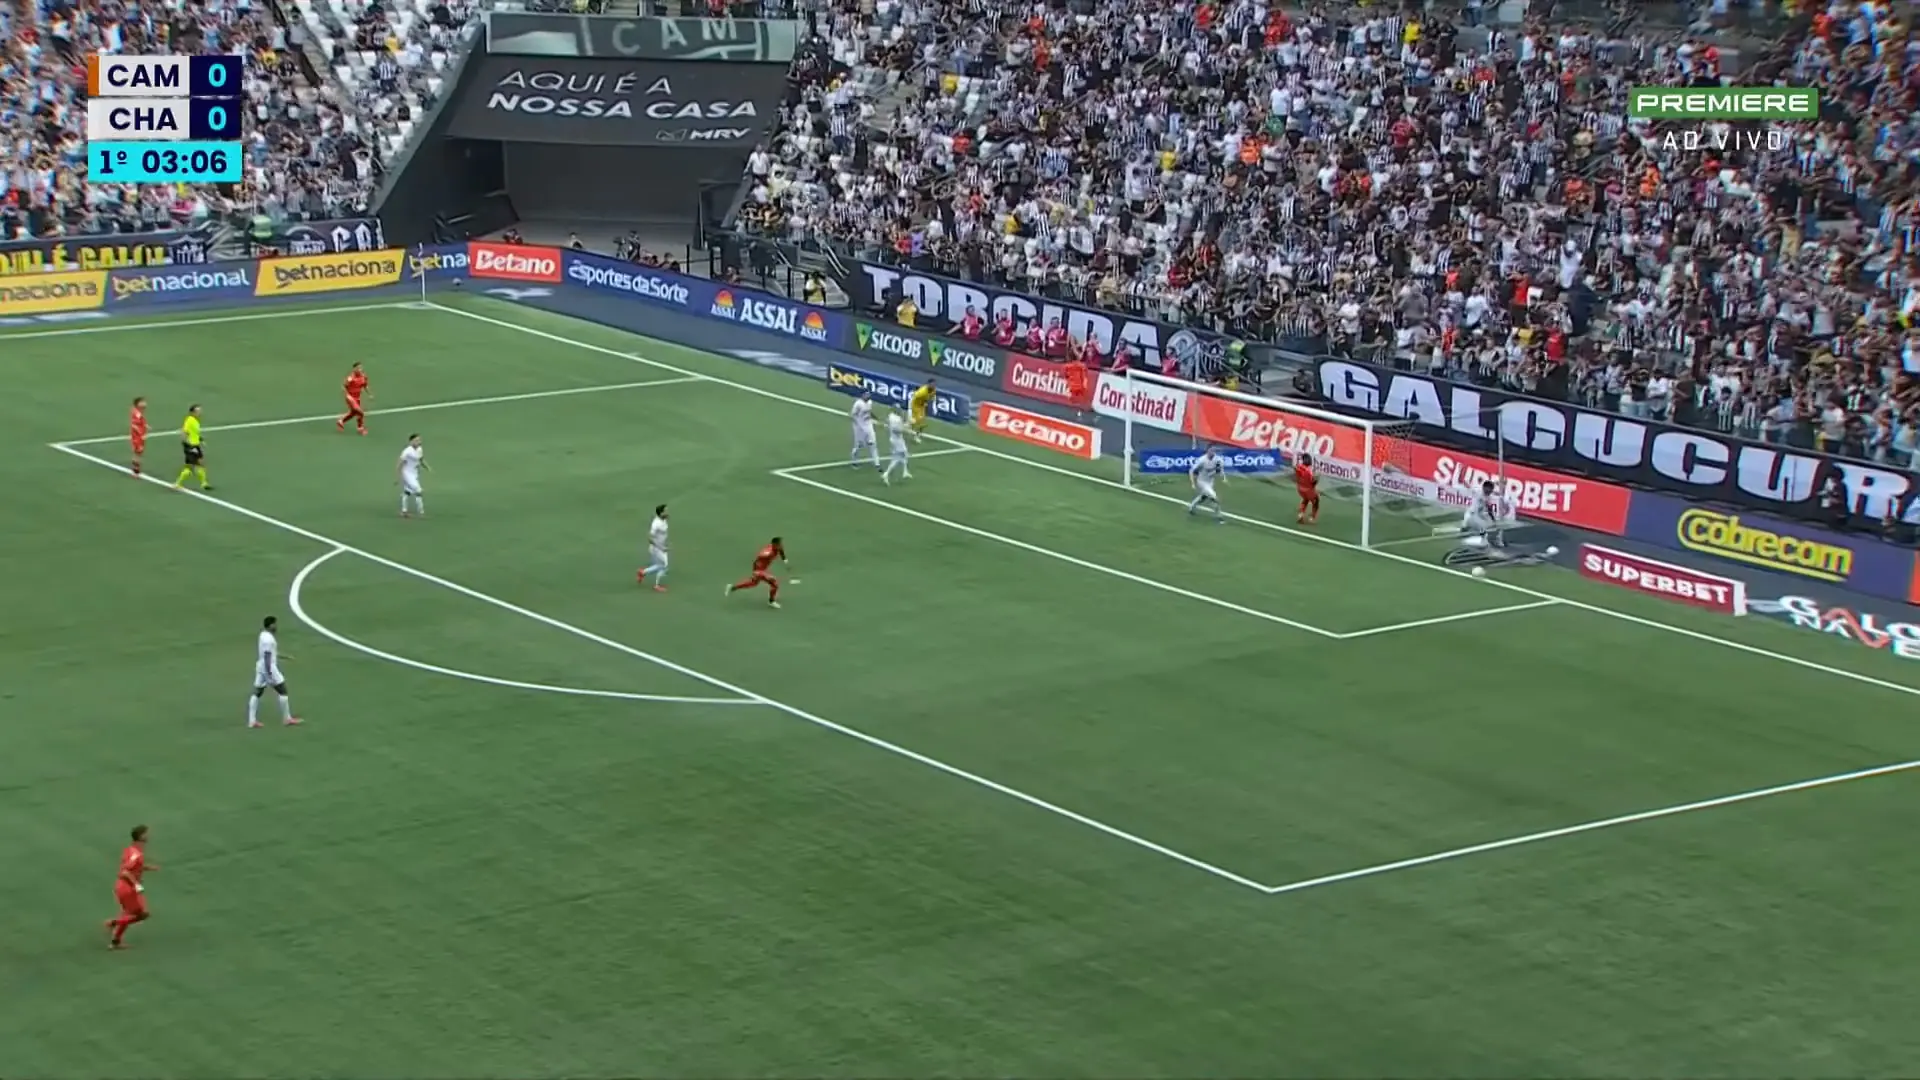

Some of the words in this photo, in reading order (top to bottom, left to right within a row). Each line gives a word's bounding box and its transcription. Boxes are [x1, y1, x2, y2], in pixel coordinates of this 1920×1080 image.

[612, 17, 738, 55] CAM
[499, 71, 606, 93] AQUI
[613, 72, 638, 94] É
[645, 78, 673, 94] A
[487, 93, 633, 118] NOSSA
[646, 101, 757, 119] CASA
[689, 128, 750, 141] MRV
[409, 253, 470, 277] betna
[475, 249, 555, 276] Betano
[113, 269, 250, 298] betnacional
[871, 330, 922, 358] SICOOB
[943, 347, 996, 377] SICOOB
[987, 410, 1085, 451] Betano
[1230, 408, 1334, 457] Betano
[1688, 514, 1853, 576] cobrecom
[1584, 554, 1730, 604] SUPERBET
